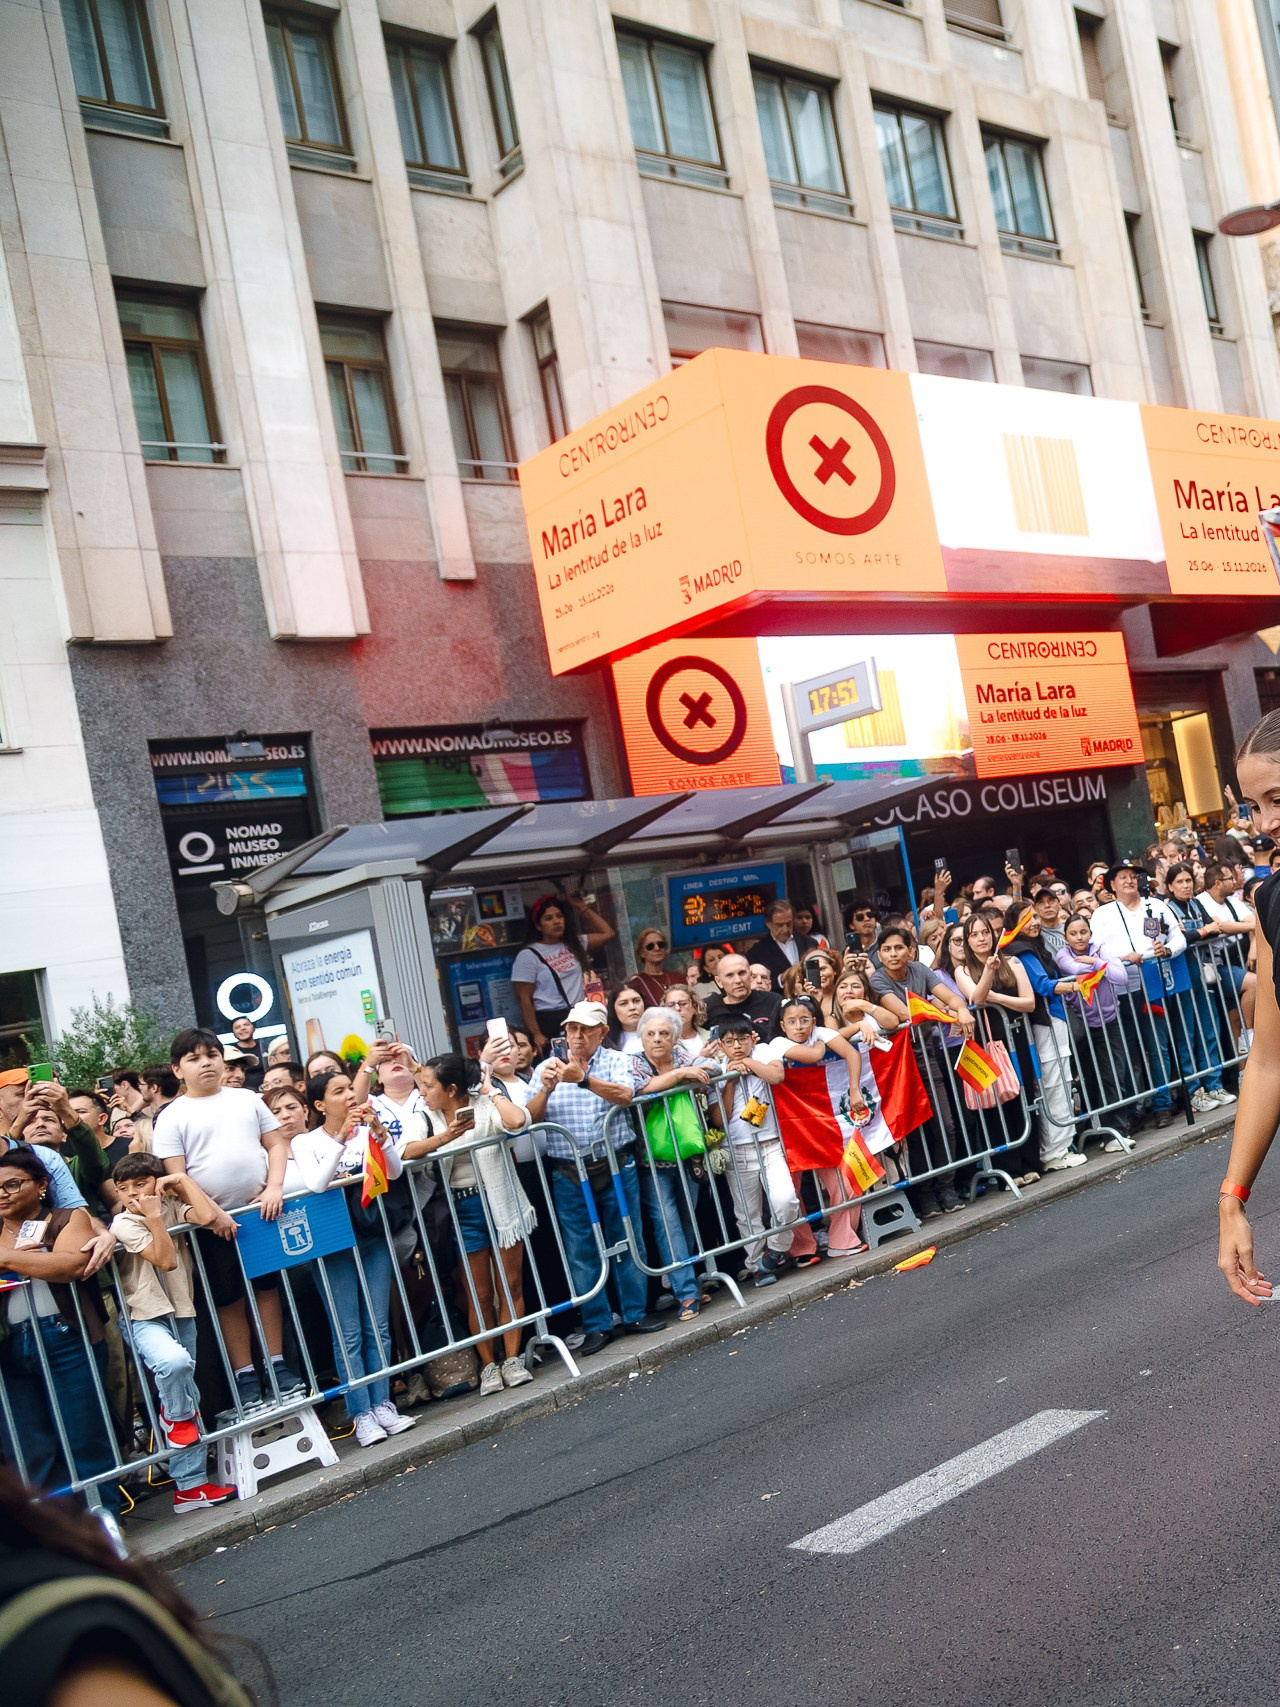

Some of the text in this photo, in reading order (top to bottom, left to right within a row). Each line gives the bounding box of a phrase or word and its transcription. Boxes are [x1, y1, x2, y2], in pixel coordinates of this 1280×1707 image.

[1173, 479, 1249, 513] María
[541, 486, 647, 559] María Lara
[1180, 522, 1260, 542] La lentitud
[548, 522, 663, 590] La lentitud de la luz
[795, 551, 903, 566] SOMOS ARTE
[1188, 560, 1214, 571] 25.06
[693, 559, 743, 594] MADRID
[809, 678, 859, 716] 17:51
[976, 681, 1077, 704] María Lara
[980, 705, 1088, 724] La lentitud de la luz
[1093, 738, 1133, 753] MADRID
[981, 774, 1107, 812] COLISEUM
[225, 823, 283, 840] NOMAD
[228, 838, 280, 854] MUSEO
[683, 881, 704, 890] LINEA
[709, 876, 739, 887] DESTINO
[732, 922, 752, 933] EMT
[324, 945, 352, 965] energía
[294, 962, 362, 992] con sentido común
